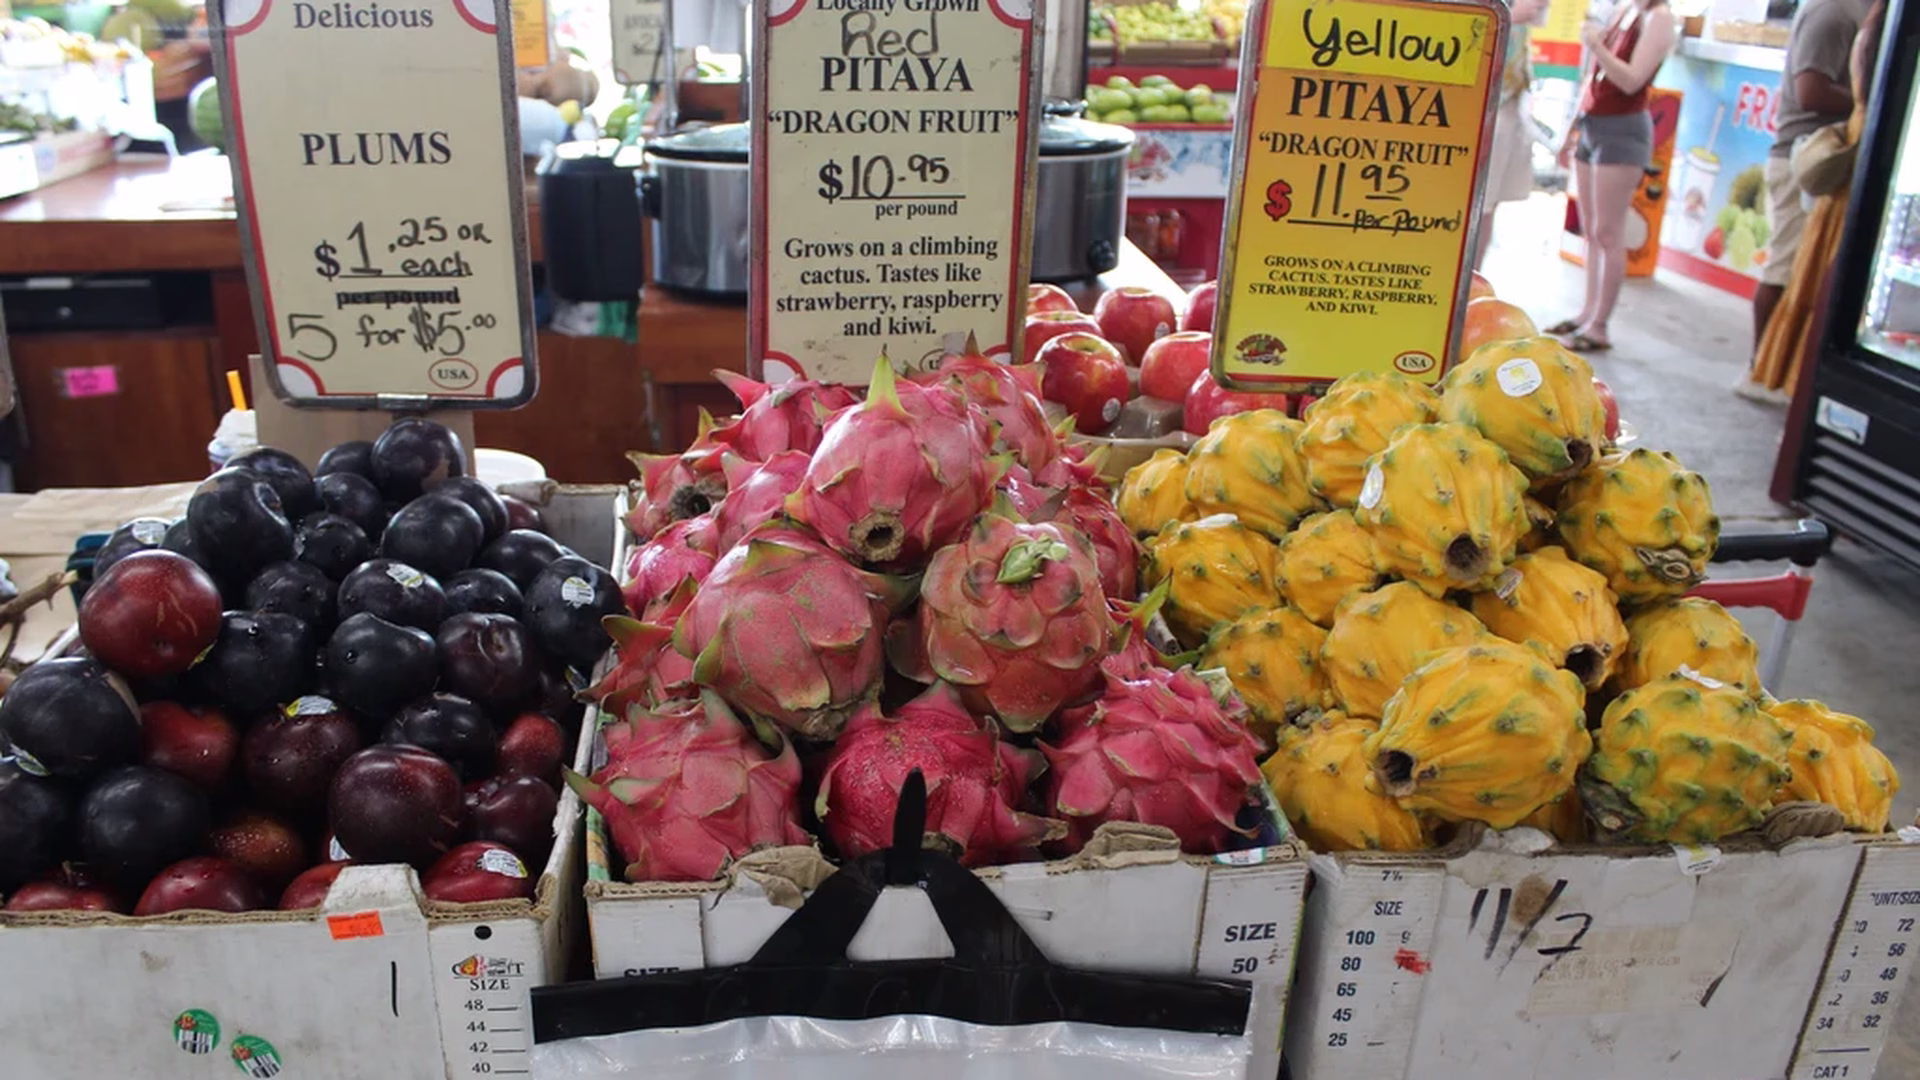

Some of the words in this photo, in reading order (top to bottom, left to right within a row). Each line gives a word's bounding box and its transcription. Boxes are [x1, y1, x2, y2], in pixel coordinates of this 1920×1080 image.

[293, 3, 433, 28] Delicious
[841, 10, 938, 56] Red
[1303, 8, 1460, 67] Yellow
[820, 57, 973, 91] PITAYA
[1286, 76, 1450, 127] PITAYA
[301, 132, 452, 165] PLUMS
[875, 203, 903, 220] per
[907, 201, 957, 219] pound
[785, 238, 853, 258] Grows
[859, 242, 884, 257] on
[892, 242, 902, 255] a
[909, 237, 998, 260] climbing
[401, 251, 473, 276] each
[1264, 255, 1319, 269] GROWS
[1322, 259, 1344, 270] ON
[1346, 261, 1355, 271] A
[1357, 262, 1432, 277] CLIMBING
[800, 268, 870, 284] cactus.
[877, 263, 939, 282] Tastes
[945, 263, 981, 281] like
[1268, 270, 1330, 284] CACTUS.
[1334, 274, 1385, 287] TASTES
[1388, 277, 1422, 290] LIKE
[776, 291, 897, 315] strawberry,
[902, 289, 1003, 313] raspberry
[1306, 301, 1336, 313] AND
[843, 317, 881, 336] and
[888, 316, 936, 335] kiwi.
[287, 314, 337, 361] 5
[356, 314, 406, 348] for
[1401, 357, 1427, 368] USA
[437, 368, 470, 380] USA
[1374, 901, 1403, 916] SIZE
[1224, 922, 1277, 943] SIZE
[1897, 918, 1915, 932] 72
[1346, 930, 1375, 945] 100
[1231, 957, 1258, 975] 50
[1341, 957, 1362, 971] 80
[1879, 967, 1898, 981] 48
[469, 979, 511, 991] SIZE
[1336, 982, 1357, 997] 65
[464, 1000, 484, 1011] 48
[1870, 992, 1889, 1005] 36
[1332, 1008, 1352, 1022] 45
[1816, 1017, 1835, 1030] 34
[1862, 1015, 1881, 1029] 32
[466, 1021, 486, 1032] 44
[469, 1042, 488, 1053] 42
[1328, 1033, 1348, 1047] 25
[471, 1063, 491, 1074] 40
[1813, 1066, 1839, 1079] CAT
[1841, 1066, 1849, 1078] 1
